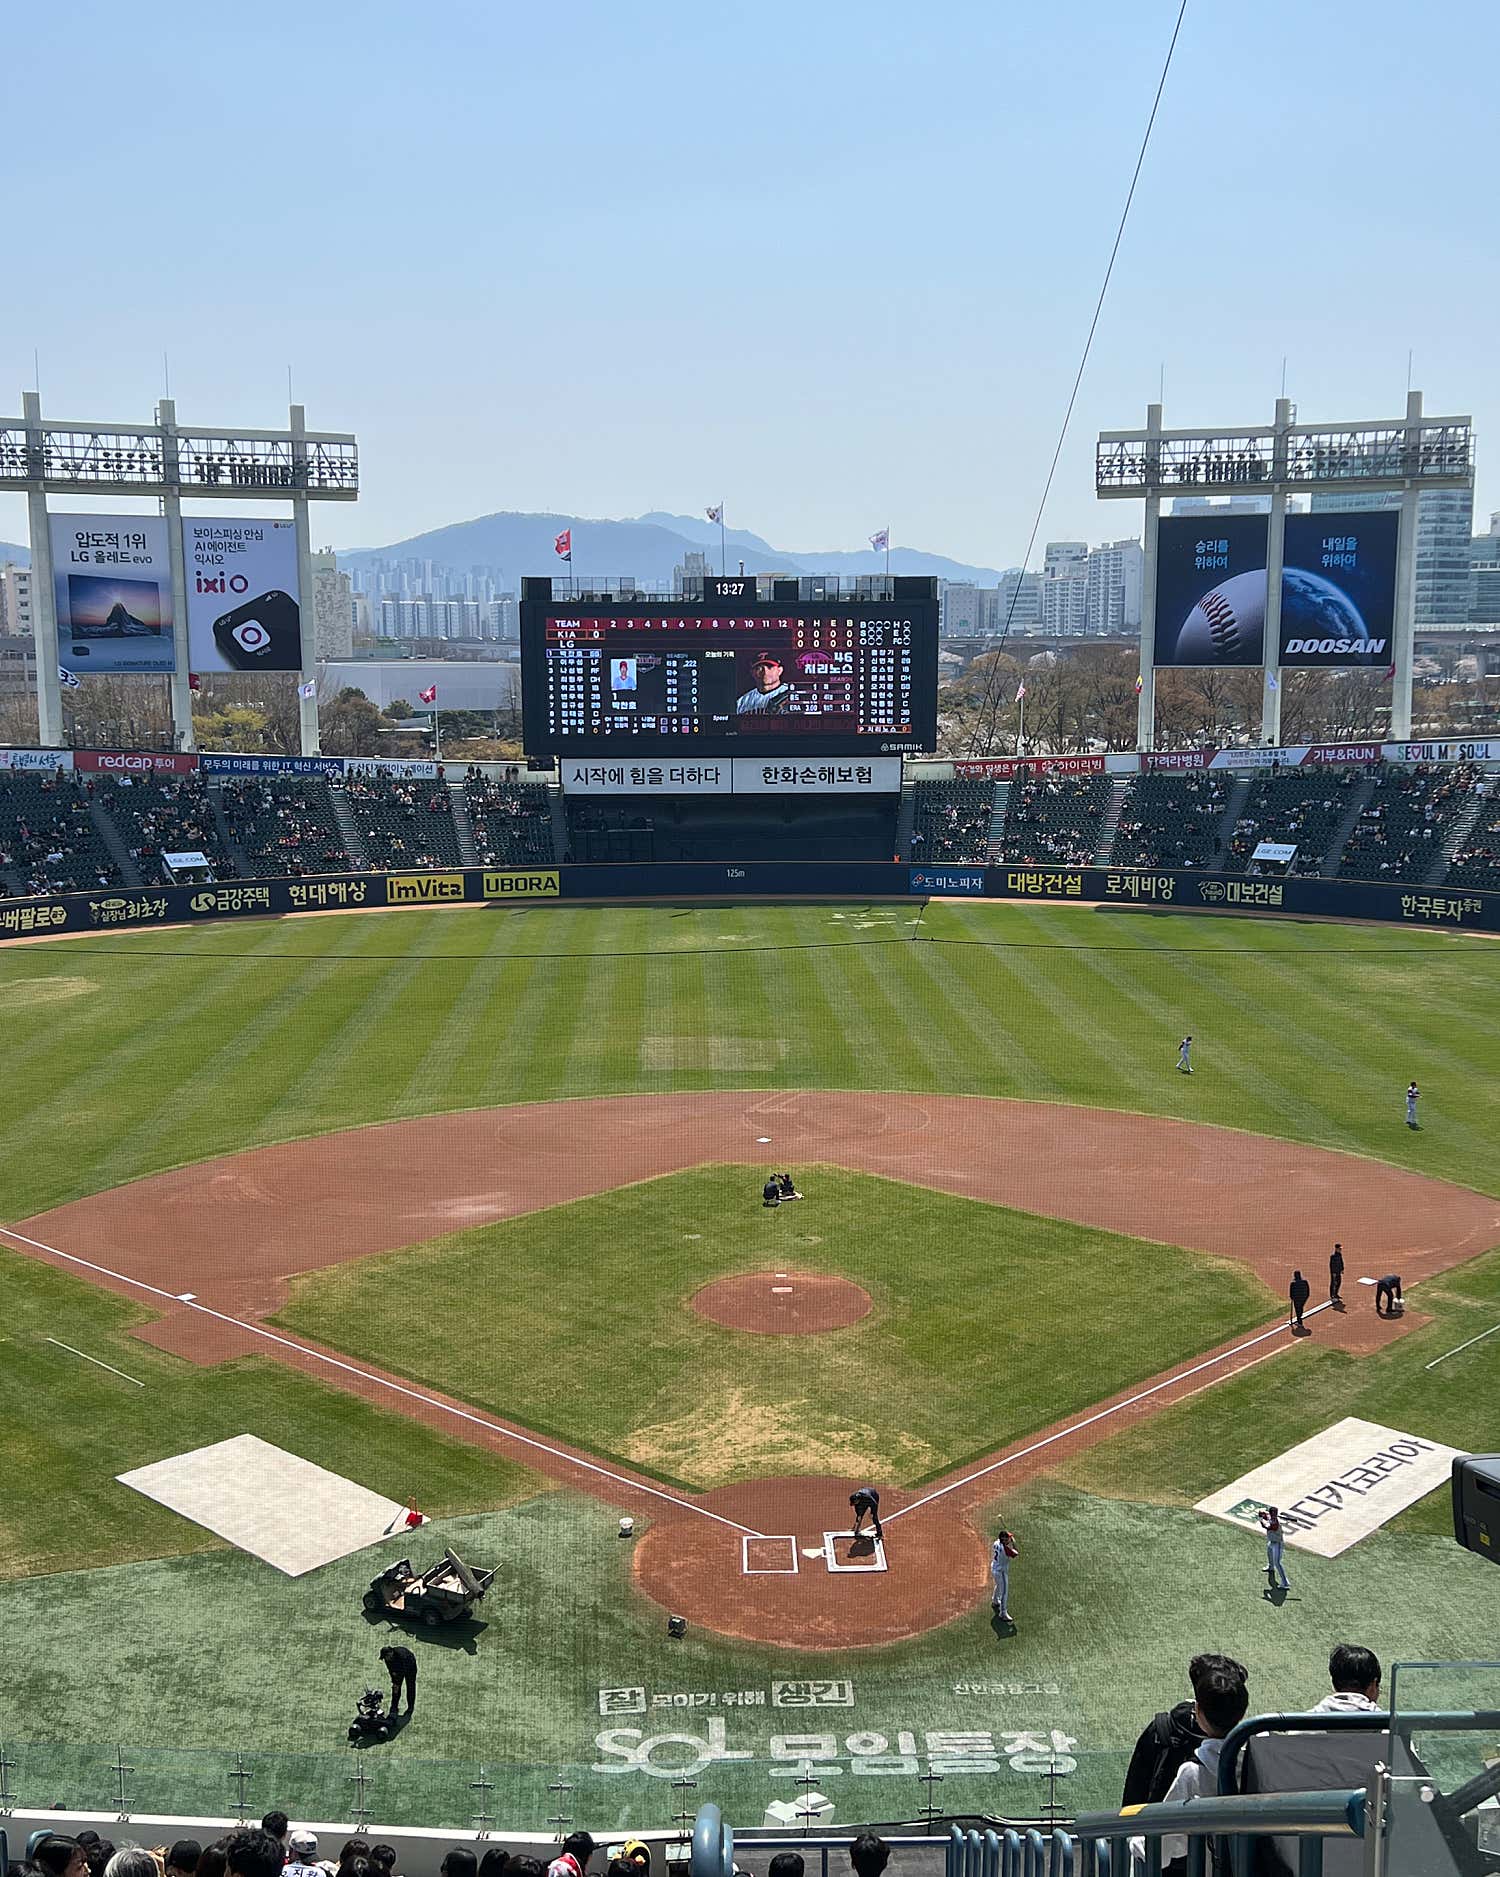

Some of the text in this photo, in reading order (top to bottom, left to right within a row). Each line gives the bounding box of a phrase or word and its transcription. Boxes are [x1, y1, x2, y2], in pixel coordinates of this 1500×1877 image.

[75, 532, 146, 550] 압도적 1위
[193, 528, 264, 541] 보이스피싱 안심
[194, 541, 248, 553] AI 에이전트
[1195, 539, 1230, 554] 승리를
[1322, 536, 1358, 551] 내일을
[71, 551, 153, 564] LG 올레드 evo
[194, 554, 225, 566] 익시오
[1194, 556, 1228, 570] 위하여
[1321, 553, 1357, 568] 위하여
[715, 583, 744, 596] 13:27
[555, 619, 853, 628] TEAM 1 2 3 4 5 6 7 8 9 10 11 12 R H E B
[860, 621, 900, 629] B H
[557, 630, 853, 639] KIA 0 0 0 0 0
[560, 640, 853, 648] LG 0 0 0 0
[1285, 638, 1386, 655] DOOSAN
[833, 652, 853, 663] 46
[804, 663, 854, 674] 치리노스
[691, 687, 698, 695] 0
[844, 683, 851, 691] 0
[691, 696, 698, 704] 0
[811, 693, 818, 701] 0
[844, 693, 851, 701] 0
[889, 743, 923, 751] SAMIK
[1459, 743, 1491, 761] SOUL
[39, 753, 61, 769] 서울
[98, 754, 175, 770] redcap 투어
[1314, 747, 1375, 763] 기부&RUN
[204, 759, 231, 770] 모두의
[233, 760, 260, 771] 미래를
[262, 760, 280, 771] 위한
[282, 761, 291, 770] IT
[573, 767, 721, 786] 시작에 힘을 더하다
[761, 766, 873, 786] 한화손해보험
[726, 868, 746, 878] 125m
[485, 875, 559, 894] UBORA
[923, 875, 984, 890] 도미노피자
[1007, 872, 1083, 896] 대방건설
[1105, 874, 1176, 900] 로제비앙
[216, 886, 270, 911] 금강주택
[288, 880, 367, 907] 현대해상
[1226, 882, 1283, 906] 대보건설
[602, 1680, 849, 1713] 잘 모이기 위해 생긴
[591, 1715, 1078, 1779] SOL 모임통장
